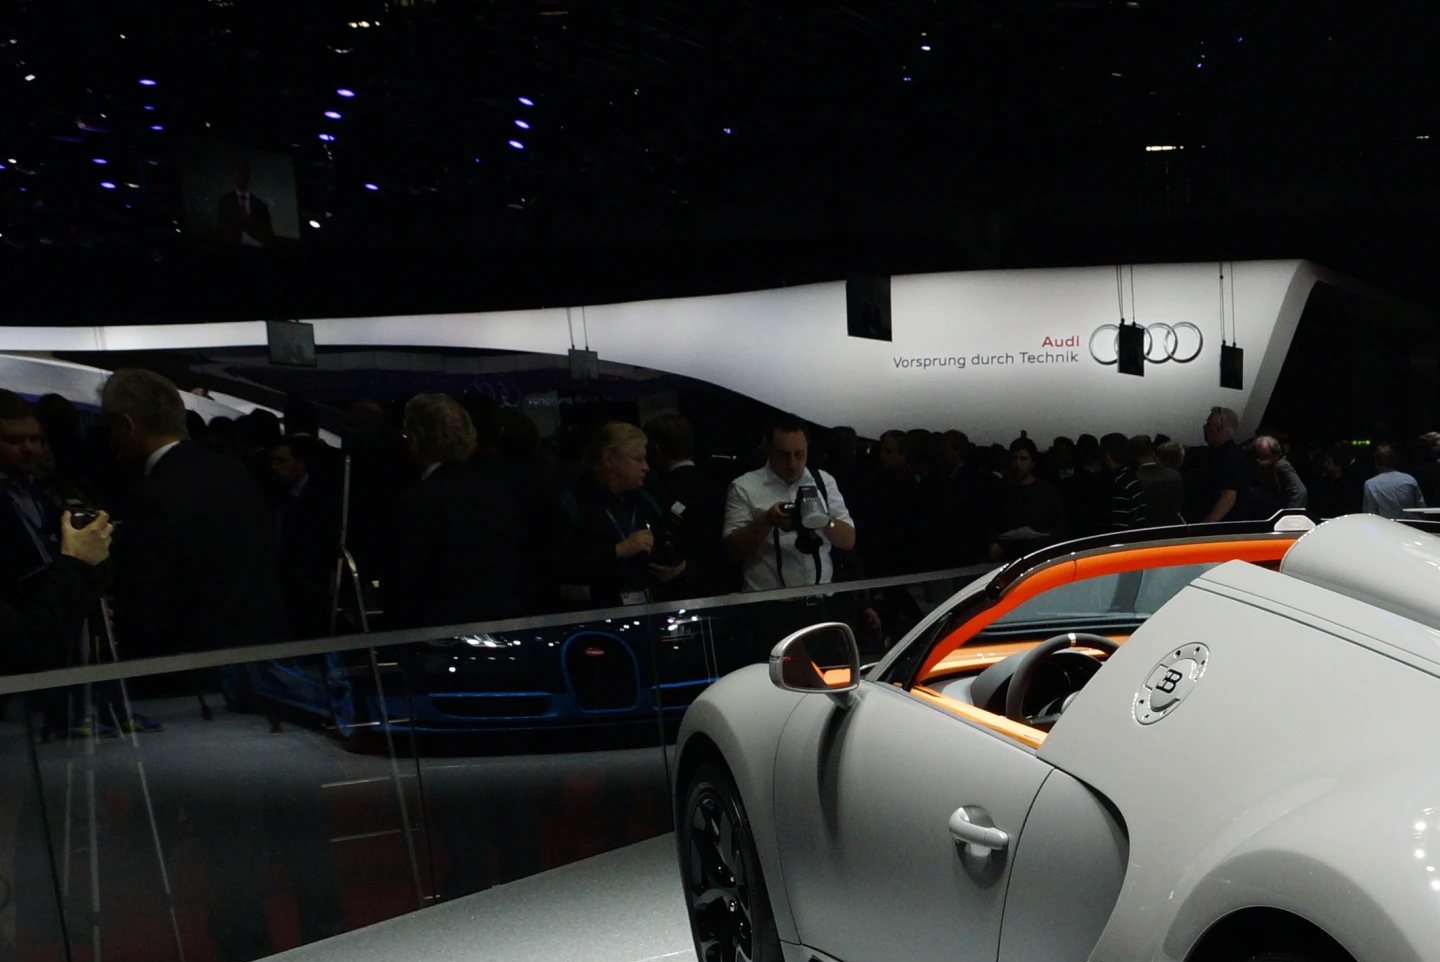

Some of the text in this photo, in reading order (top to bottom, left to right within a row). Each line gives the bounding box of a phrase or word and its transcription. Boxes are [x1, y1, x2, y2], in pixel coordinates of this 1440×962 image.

[1041, 335, 1080, 348] Audi
[893, 350, 1079, 370] Vorsprung durch Technik
